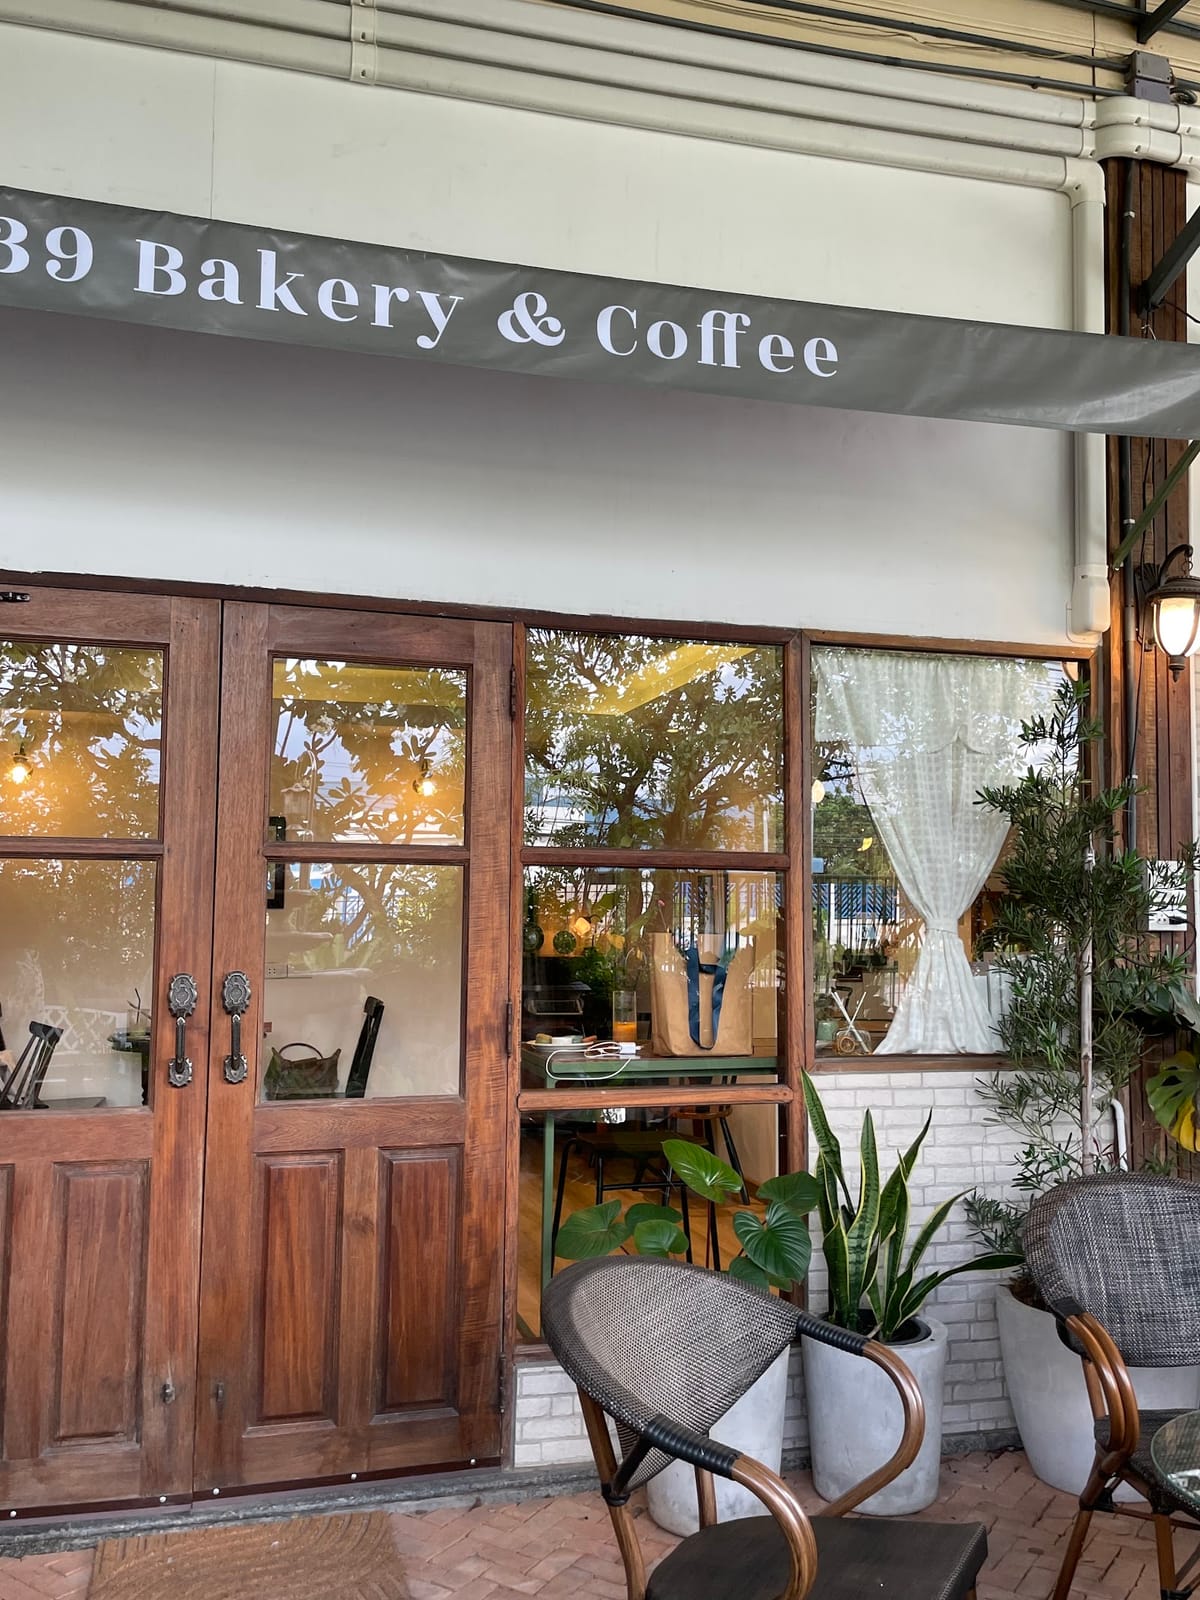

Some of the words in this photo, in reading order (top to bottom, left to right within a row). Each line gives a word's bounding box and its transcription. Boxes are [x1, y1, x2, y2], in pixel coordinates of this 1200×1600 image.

[133, 239, 463, 349] Bakery
[497, 292, 566, 347] &
[596, 305, 838, 378] Coffee
